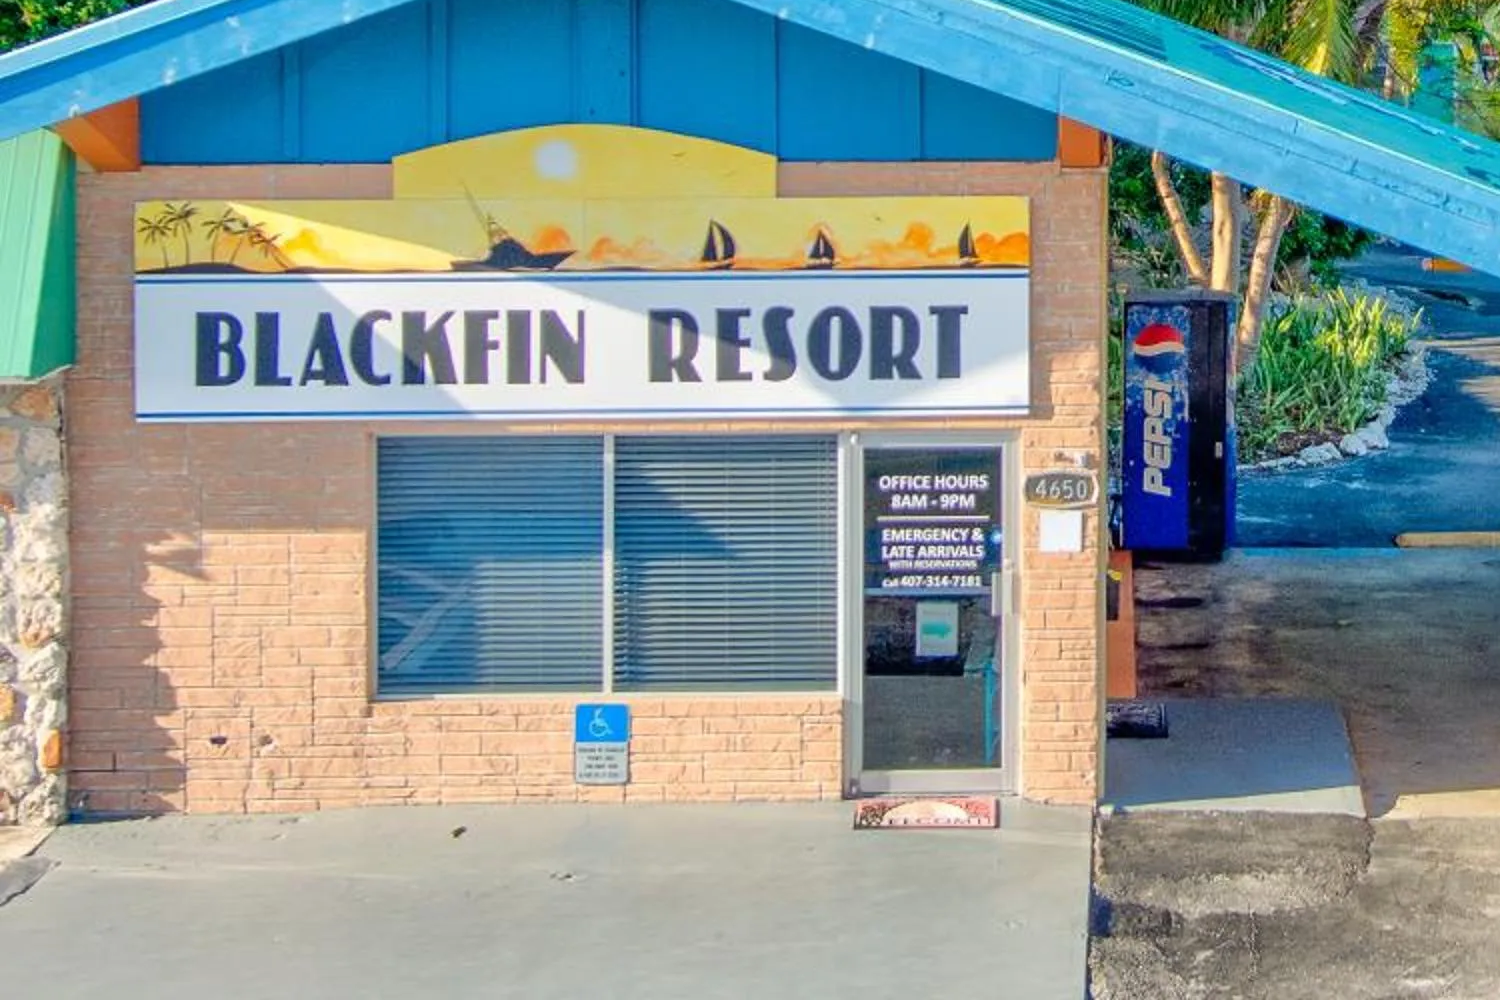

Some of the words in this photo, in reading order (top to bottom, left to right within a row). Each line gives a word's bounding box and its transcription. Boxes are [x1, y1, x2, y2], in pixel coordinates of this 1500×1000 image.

[195, 308, 586, 388] BLACKFIN
[648, 304, 969, 384] RESORT
[1142, 379, 1173, 497] PEPSI
[879, 475, 931, 490] OFFICE
[934, 474, 989, 490] HOURS
[1036, 479, 1088, 499] 4650
[891, 494, 927, 508] 8AM
[940, 494, 975, 508] 9PM
[882, 528, 969, 541] EMERGENCY
[971, 527, 984, 541] &
[882, 545, 914, 558] LATE
[917, 545, 985, 558] ARRIVALS
